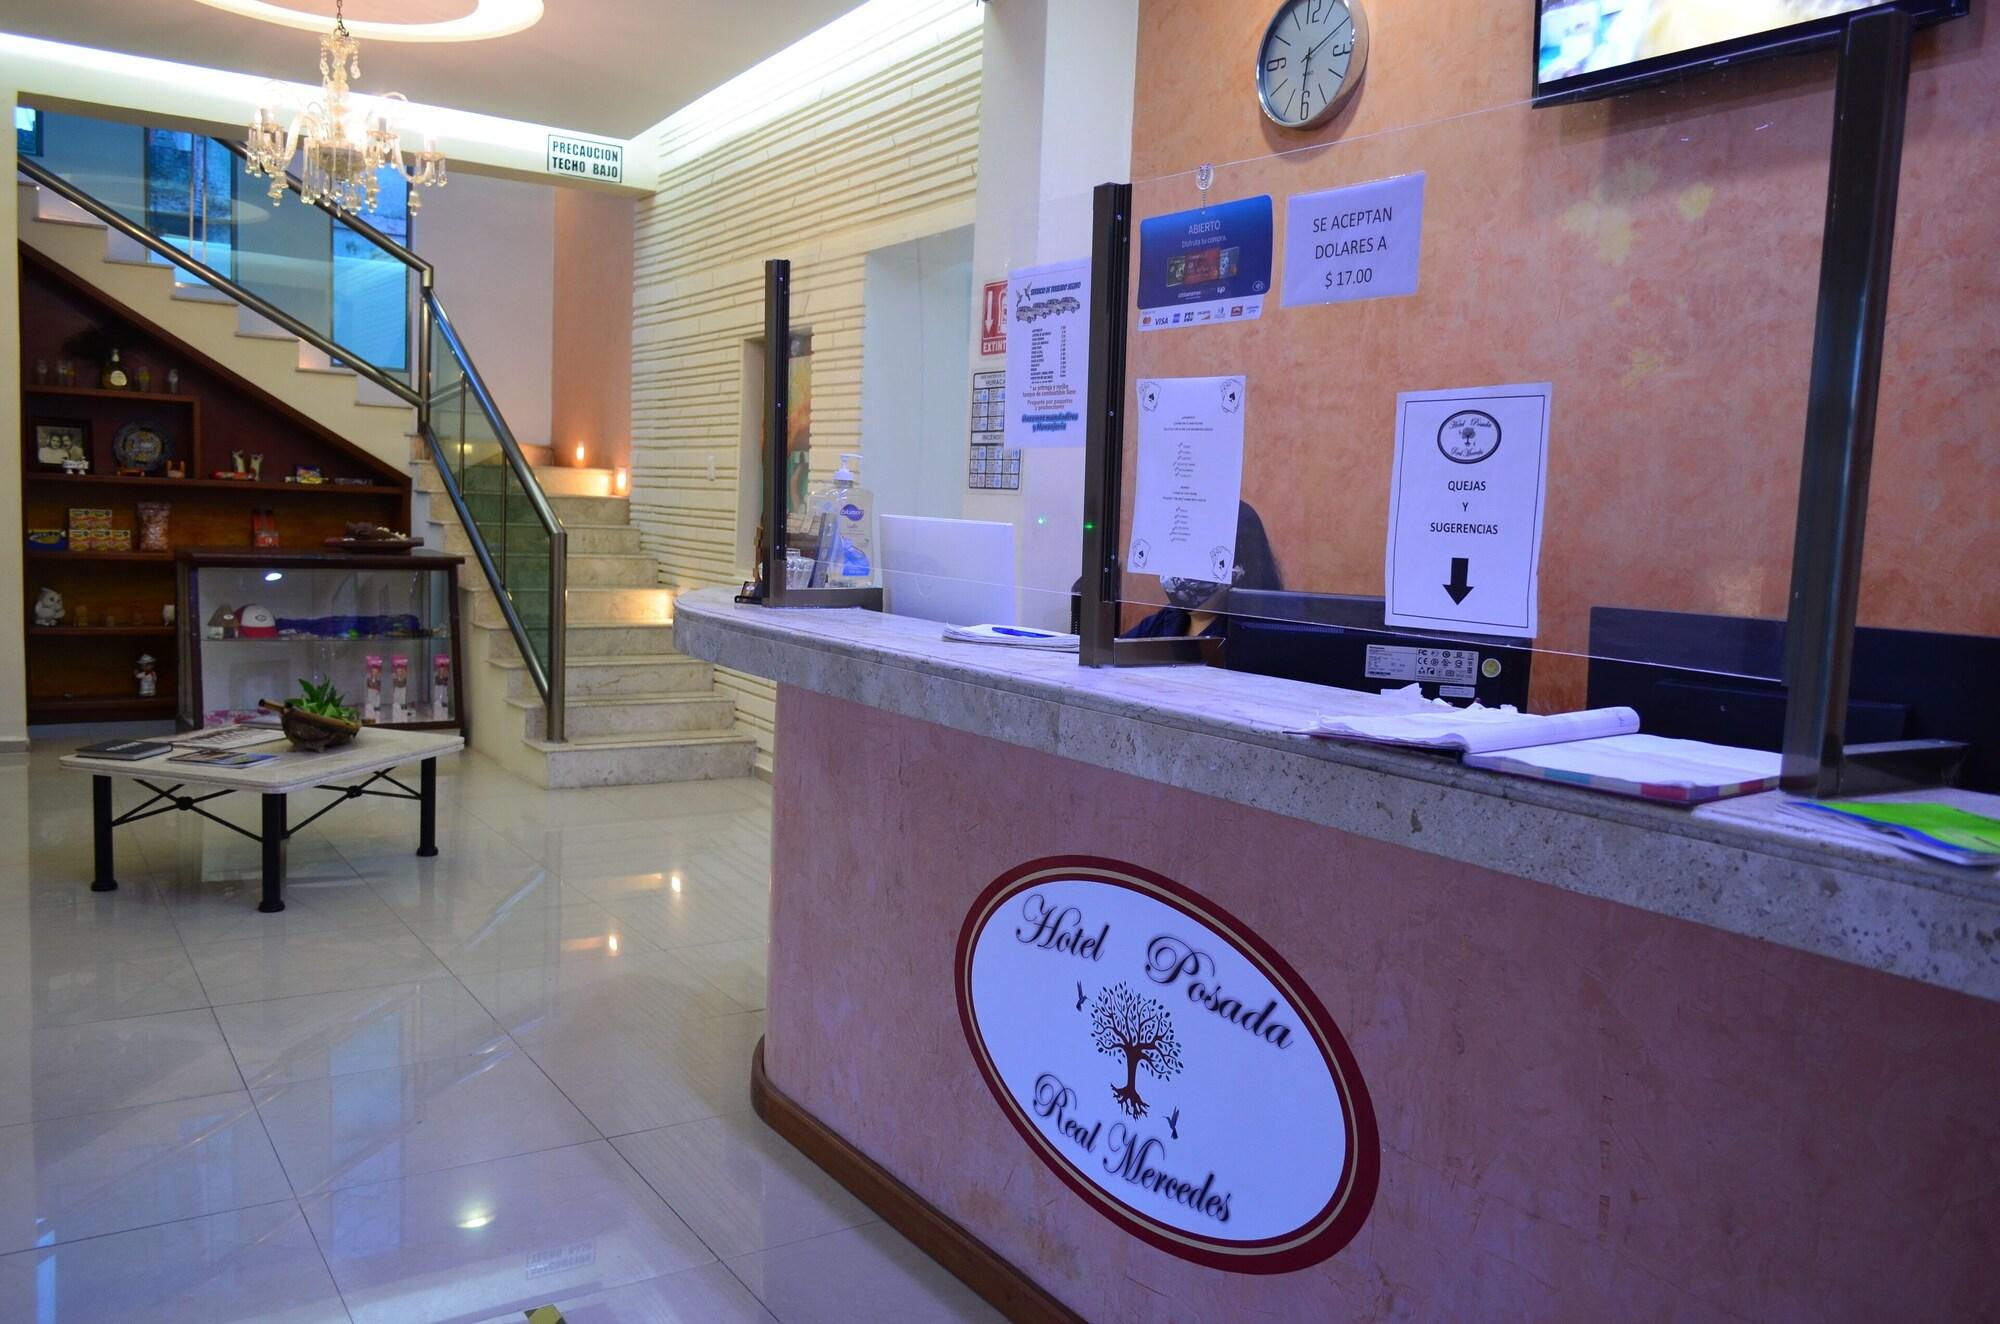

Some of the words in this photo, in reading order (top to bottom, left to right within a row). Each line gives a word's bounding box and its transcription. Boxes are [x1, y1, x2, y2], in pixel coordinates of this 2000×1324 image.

[552, 140, 618, 162] PRECAUCION
[552, 156, 586, 173] TECHO
[592, 163, 618, 178] BAJO
[1188, 220, 1221, 235] ABIERTO
[1312, 217, 1328, 233] SE
[1330, 206, 1393, 231] ACEPTAN
[1315, 237, 1374, 260] DOLARES
[1377, 235, 1388, 251] A
[1325, 271, 1333, 289] $
[1337, 267, 1373, 286] 17.00
[1155, 317, 1169, 326] VISA
[1447, 480, 1486, 492] QUEJAS
[1462, 501, 1469, 512] Y
[1430, 522, 1498, 535] SUGERENCIAS
[1016, 893, 1110, 962] Hotel
[1145, 936, 1294, 1050] Posada
[1033, 1073, 1102, 1153] Real
[1102, 1122, 1231, 1222] Mercedes
